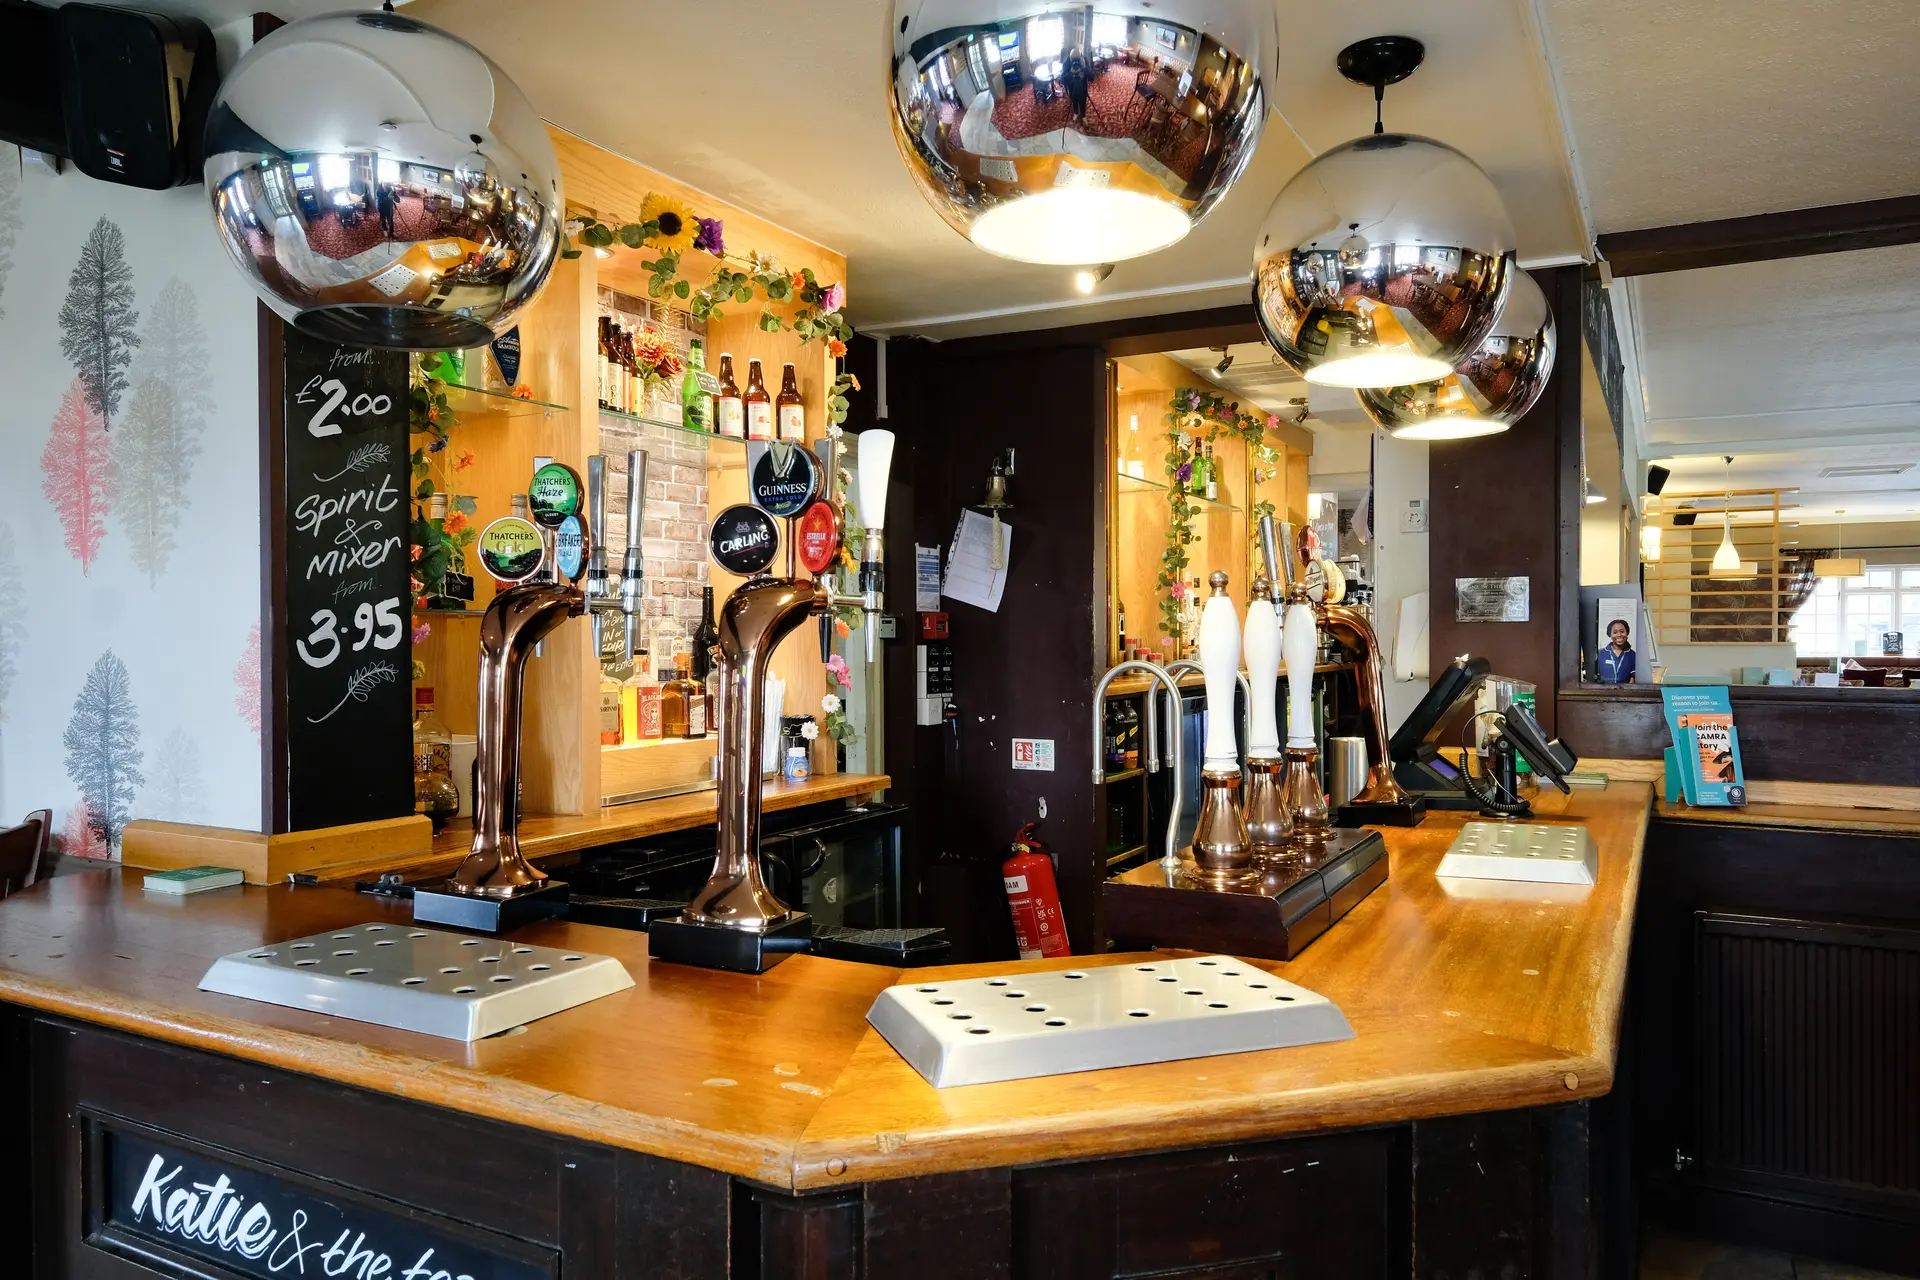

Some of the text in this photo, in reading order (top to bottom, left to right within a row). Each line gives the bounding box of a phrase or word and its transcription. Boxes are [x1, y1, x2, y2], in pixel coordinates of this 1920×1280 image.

[295, 374, 392, 438] £2.00
[534, 477, 571, 487] THATCHERS
[537, 486, 564, 497] Haze
[758, 482, 807, 497] GUINNESS
[294, 473, 399, 538] Spirit
[334, 518, 383, 546] &
[490, 532, 534, 541] THATCHERS
[719, 529, 769, 554] CARLING
[602, 629, 614, 642] IN
[1713, 723, 1728, 731] the
[1005, 881, 1019, 889] OAM
[131, 1153, 277, 1259] Katie
[267, 1209, 323, 1275] &
[320, 1228, 392, 1280] the
